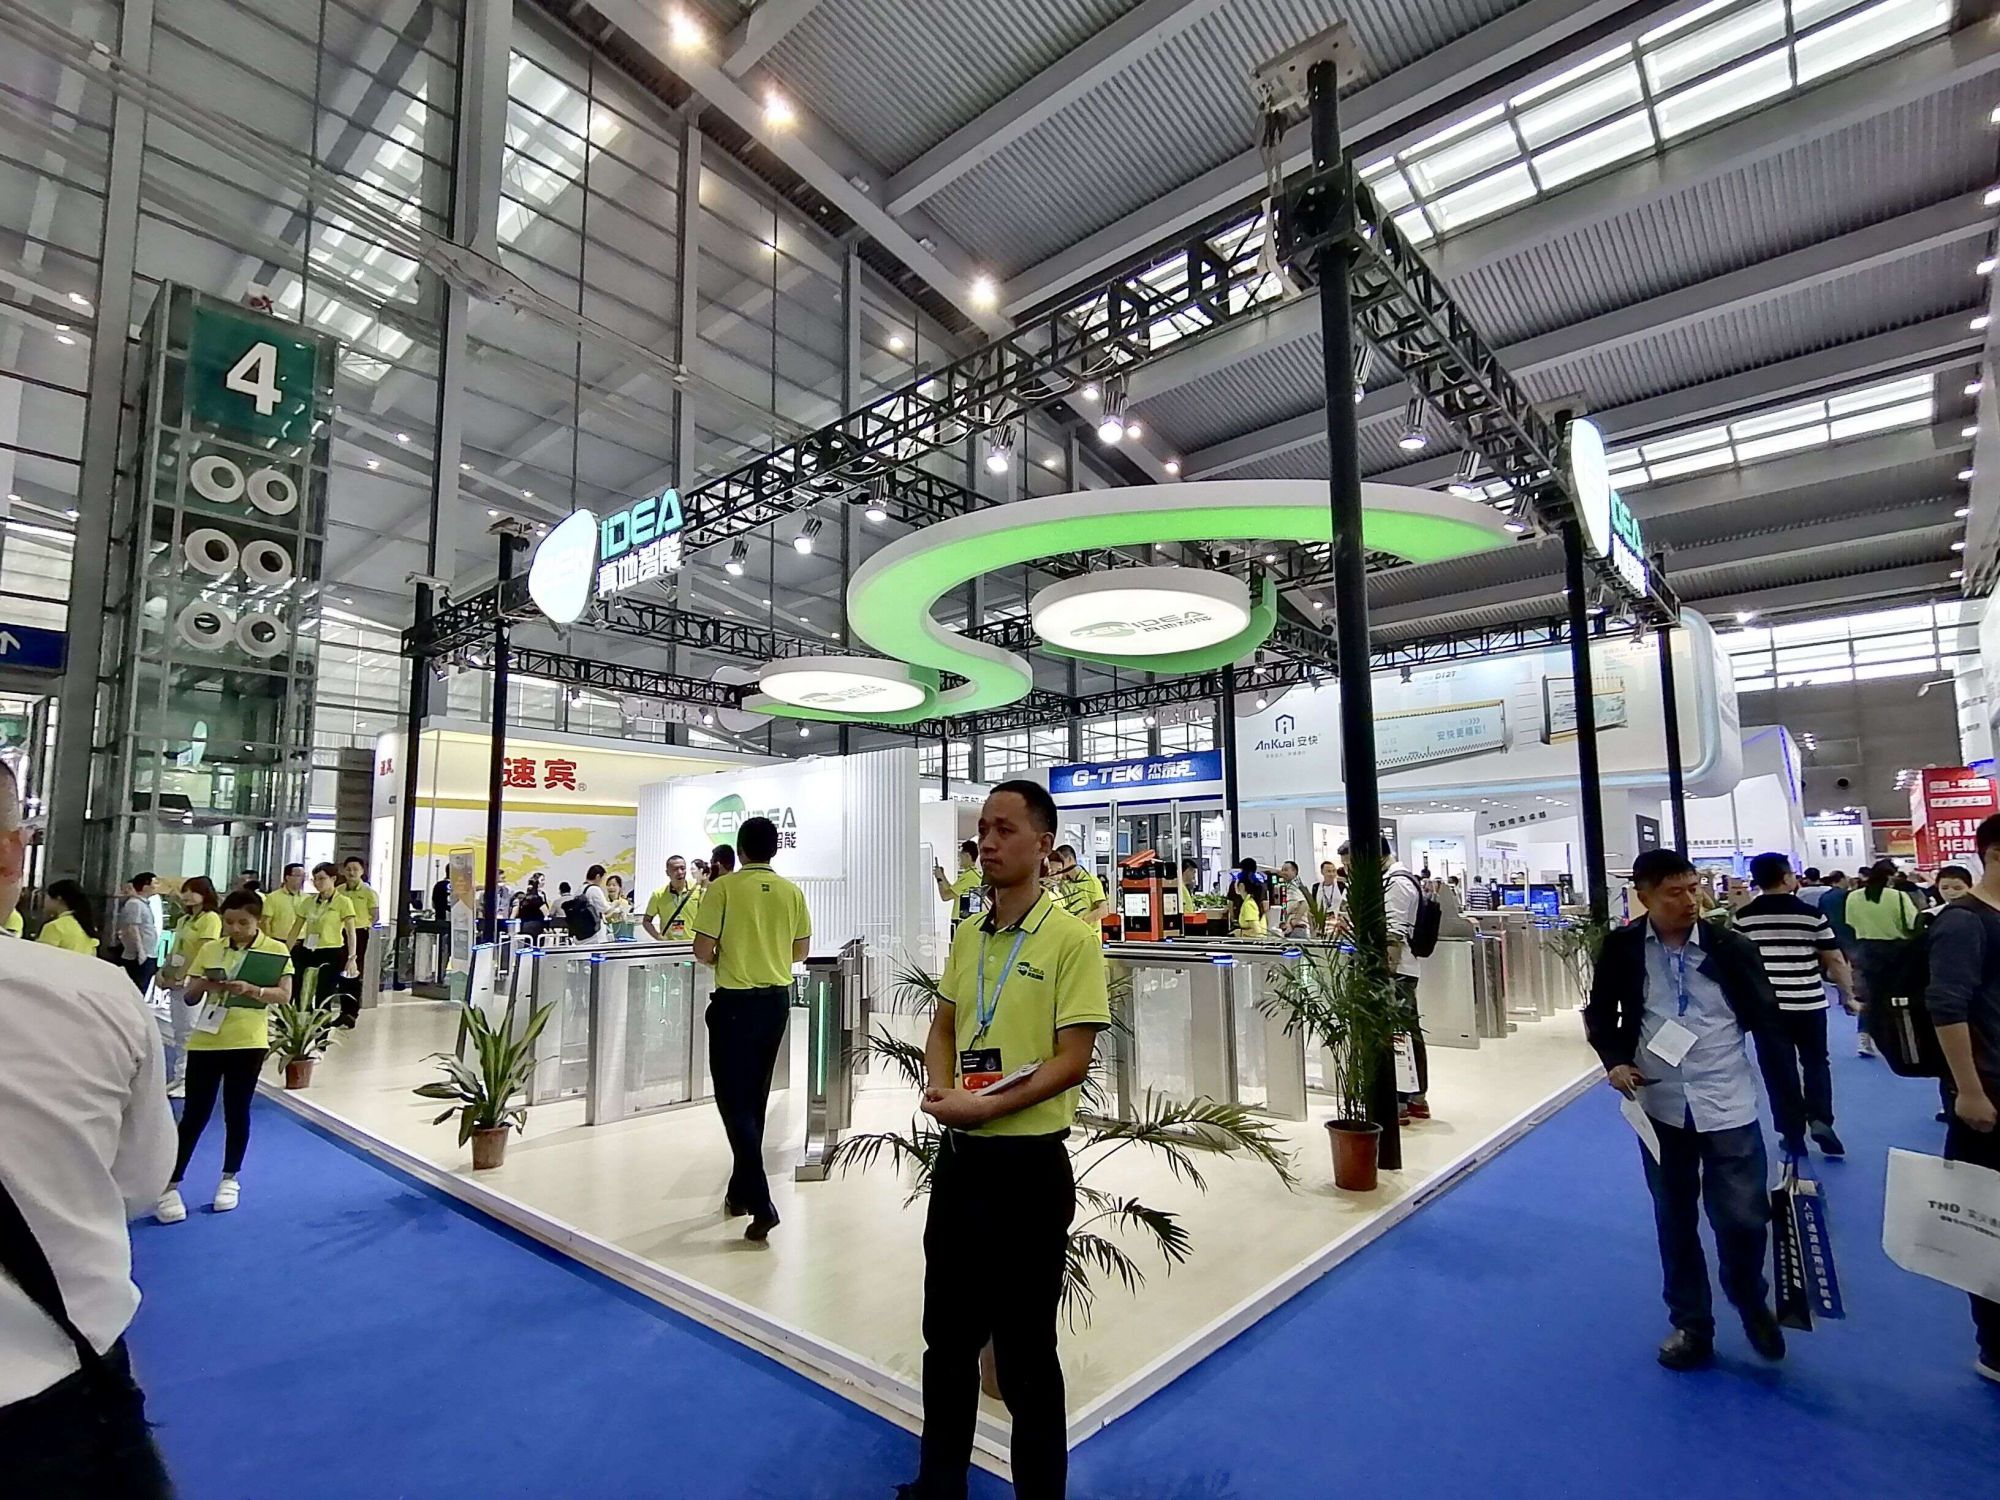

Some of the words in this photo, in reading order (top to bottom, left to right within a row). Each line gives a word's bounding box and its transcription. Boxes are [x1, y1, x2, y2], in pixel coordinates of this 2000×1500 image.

[226, 341, 282, 416] 4
[601, 488, 684, 560] IDEA
[1254, 738, 1295, 751] AnKuai
[1297, 735, 1318, 747] 安快
[502, 757, 577, 791] 速宾
[1072, 764, 1145, 787] G-TEK
